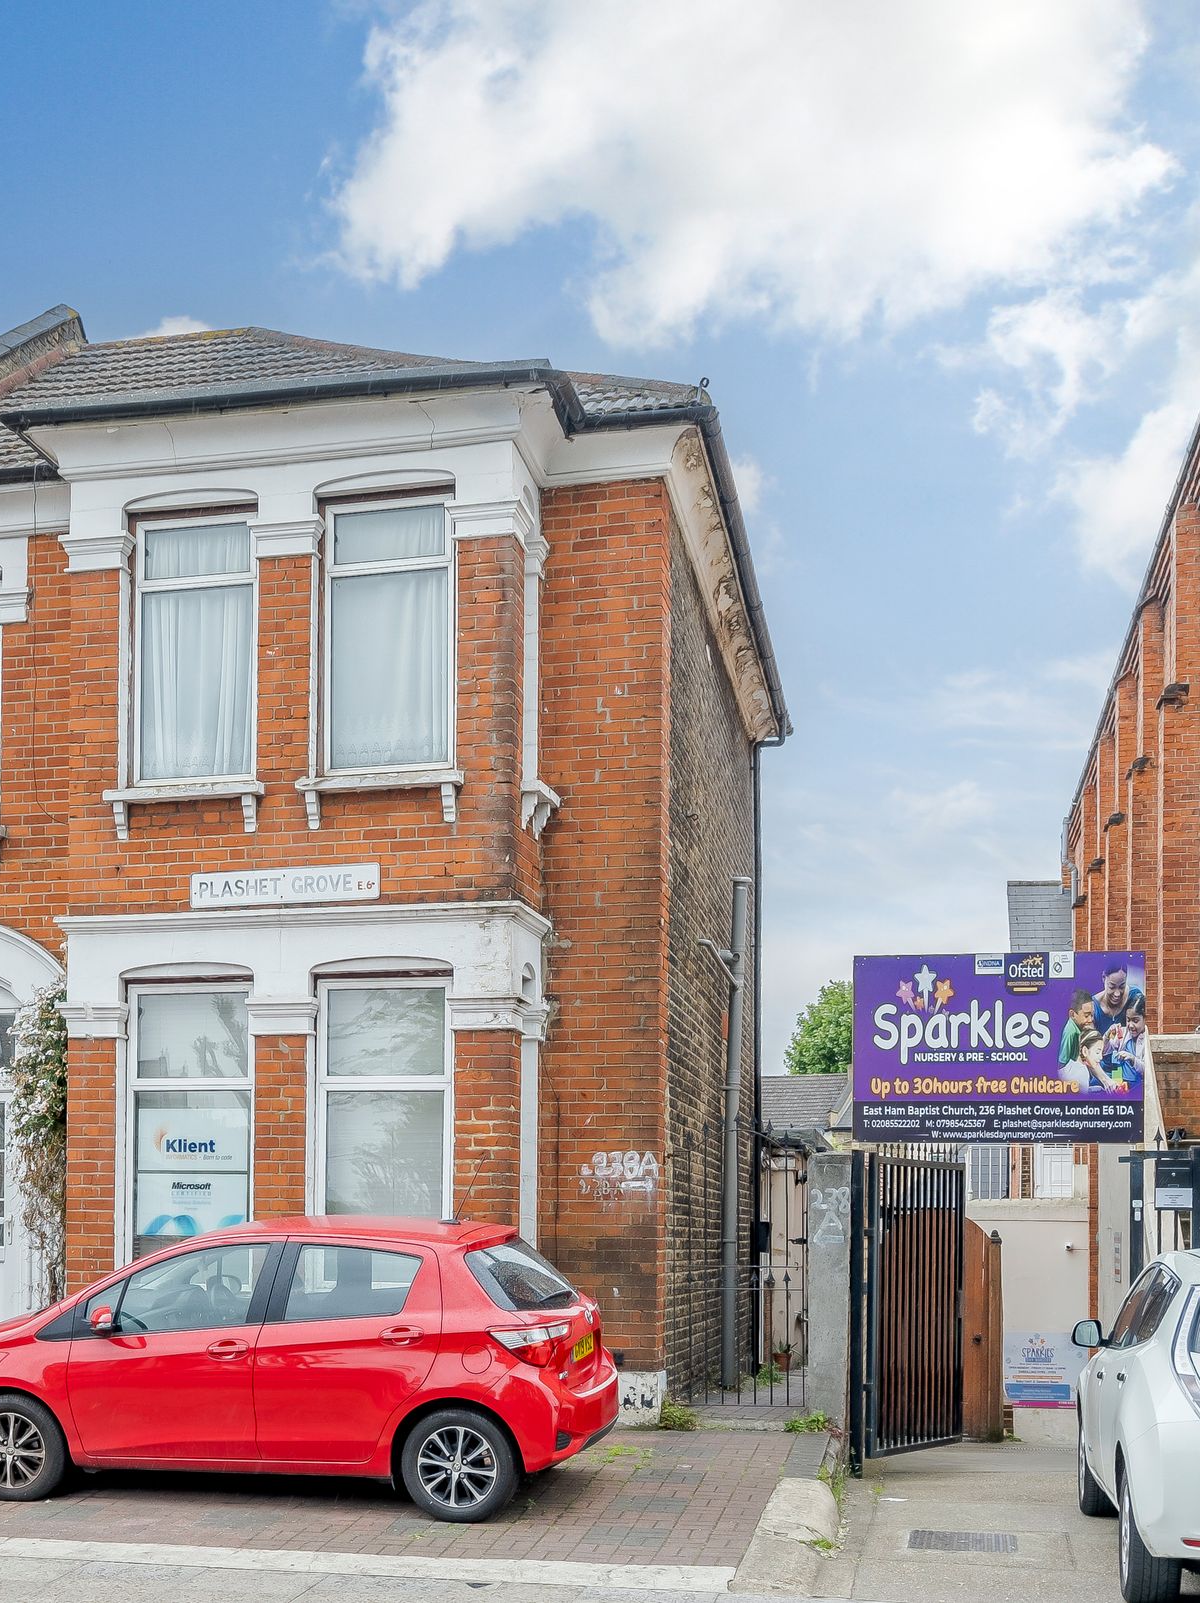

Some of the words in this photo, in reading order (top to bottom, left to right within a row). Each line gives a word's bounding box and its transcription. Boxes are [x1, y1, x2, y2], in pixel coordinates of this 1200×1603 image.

[199, 877, 281, 899] PLASHET
[291, 873, 353, 894] GROVE
[1009, 963, 1044, 978] Ofsted
[873, 999, 1051, 1065] Sparkles
[914, 1052, 957, 1062] NURSERY
[958, 1052, 965, 1061] &
[966, 1052, 984, 1061] PRE
[990, 1052, 1028, 1061] SCHOOL
[870, 1077, 890, 1099] Up
[894, 1077, 910, 1095] to
[913, 1077, 973, 1095] 30hours
[975, 1076, 1007, 1095] free
[1010, 1076, 1080, 1094] Childcare
[863, 1105, 882, 1115] East
[884, 1105, 906, 1115] Ham
[907, 1105, 940, 1117] Baptist
[942, 1105, 978, 1117] Church,
[979, 1105, 995, 1115] 236
[997, 1105, 1031, 1115] Plashet
[1033, 1105, 1063, 1117] Grove,
[1065, 1105, 1100, 1115] London
[1102, 1105, 1115, 1115] E6
[1116, 1105, 1135, 1115] 1DA
[863, 1119, 870, 1128] T:
[925, 1119, 935, 1128] M:
[993, 1119, 1001, 1128] E:
[1002, 1119, 1132, 1130] plashet@sparklesdaynursery.com
[931, 1130, 941, 1139] W:
[942, 1130, 1054, 1140] www.sparklesdaynursery.com
[166, 1139, 216, 1153] Klient
[171, 1182, 211, 1190] Microsoft
